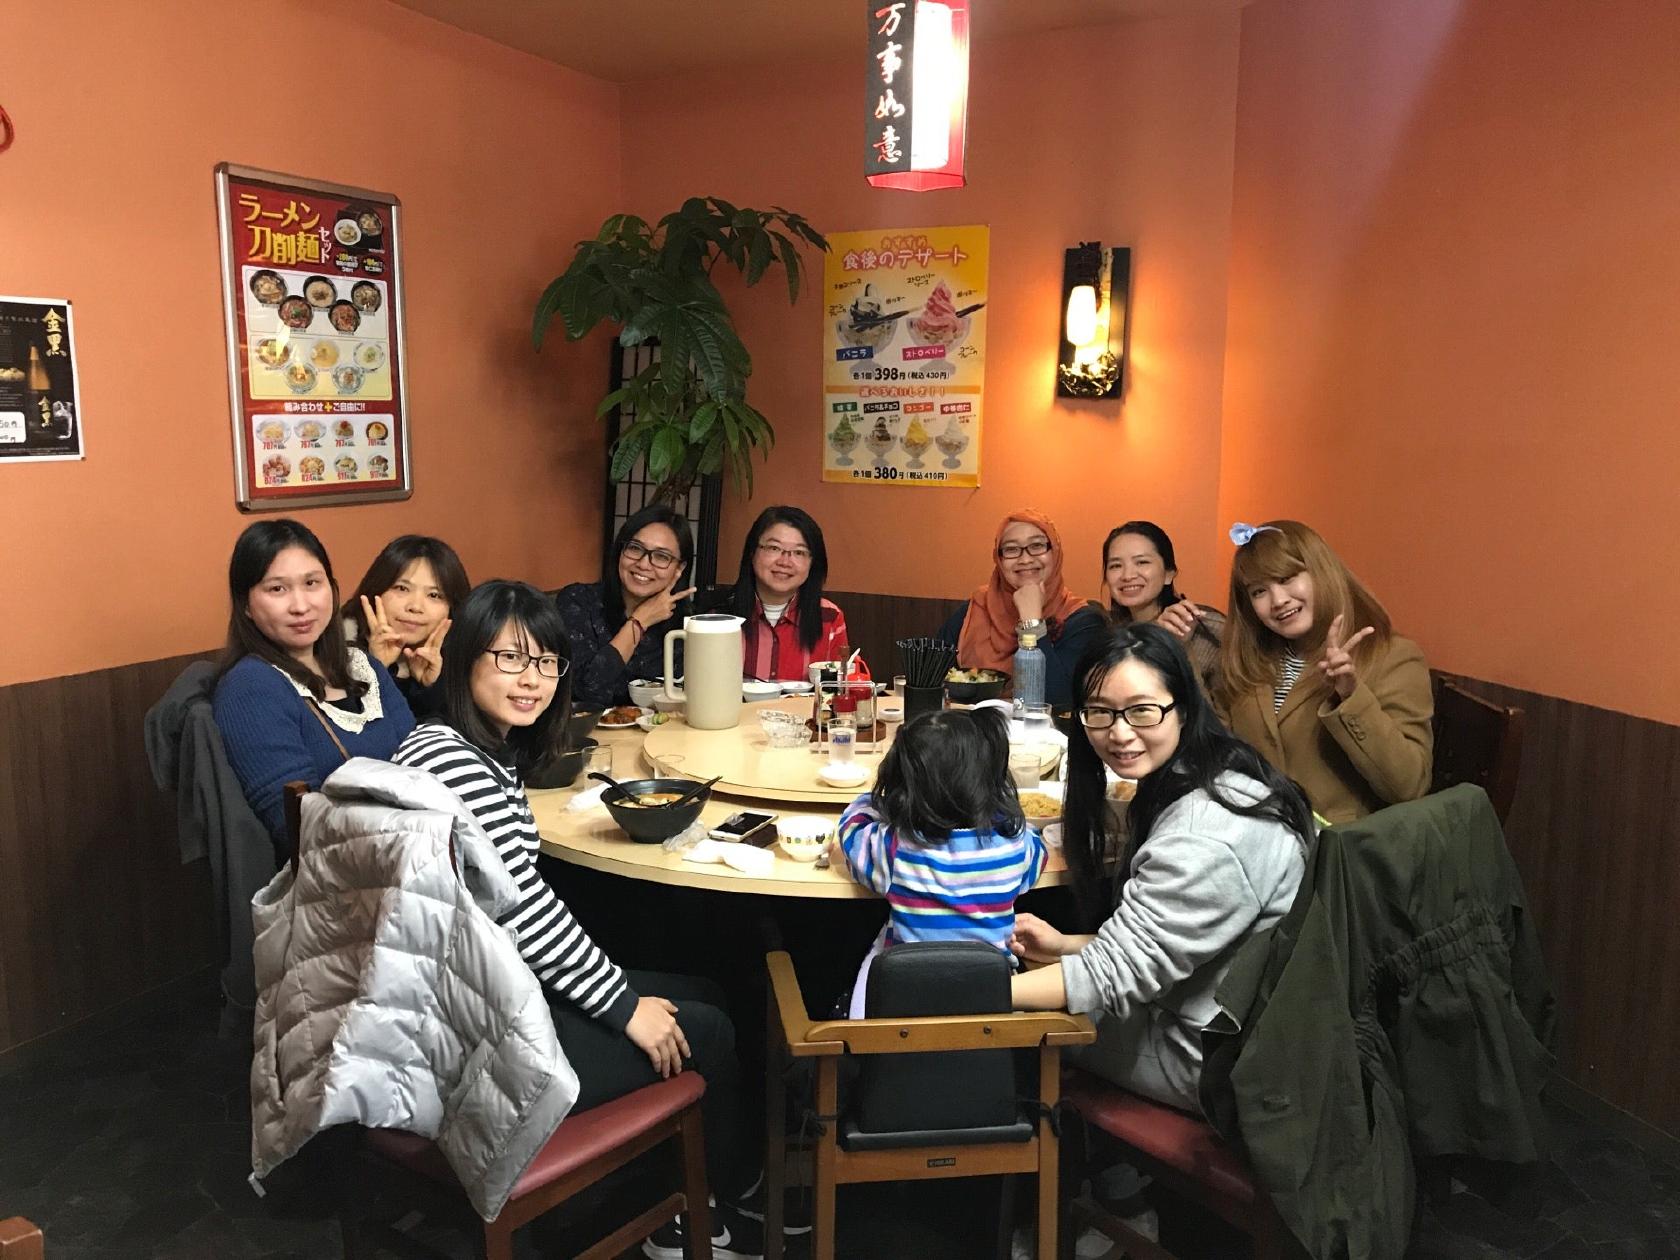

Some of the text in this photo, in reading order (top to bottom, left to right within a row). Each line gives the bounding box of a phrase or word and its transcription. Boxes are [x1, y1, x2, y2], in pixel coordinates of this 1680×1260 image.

[873, 2, 906, 163] 万事如意
[238, 193, 320, 230] ラーメン
[247, 225, 320, 265] 刀削麺
[318, 226, 333, 264] セット
[843, 246, 968, 271] 食後のデザート
[842, 348, 868, 359] バニラ
[905, 348, 945, 359] ストロベリー
